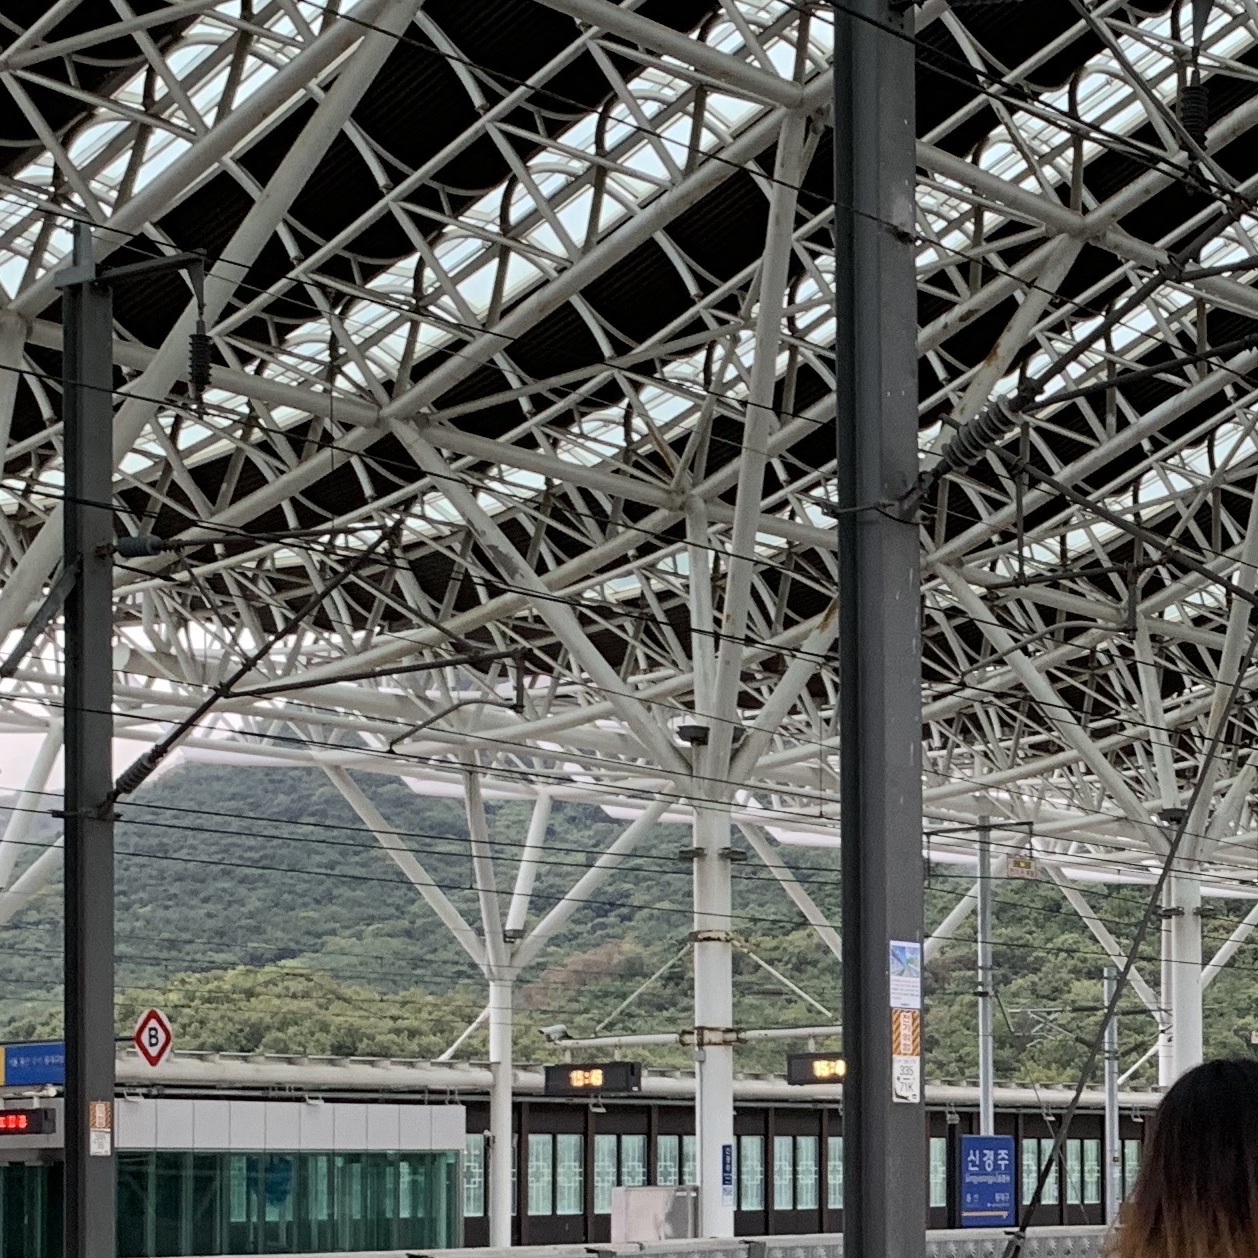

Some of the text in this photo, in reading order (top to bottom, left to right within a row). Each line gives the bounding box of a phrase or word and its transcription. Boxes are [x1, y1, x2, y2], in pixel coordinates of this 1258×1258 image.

[148, 1027, 159, 1047] B
[900, 1064, 914, 1077] 335
[967, 1149, 1009, 1171] 신경주
